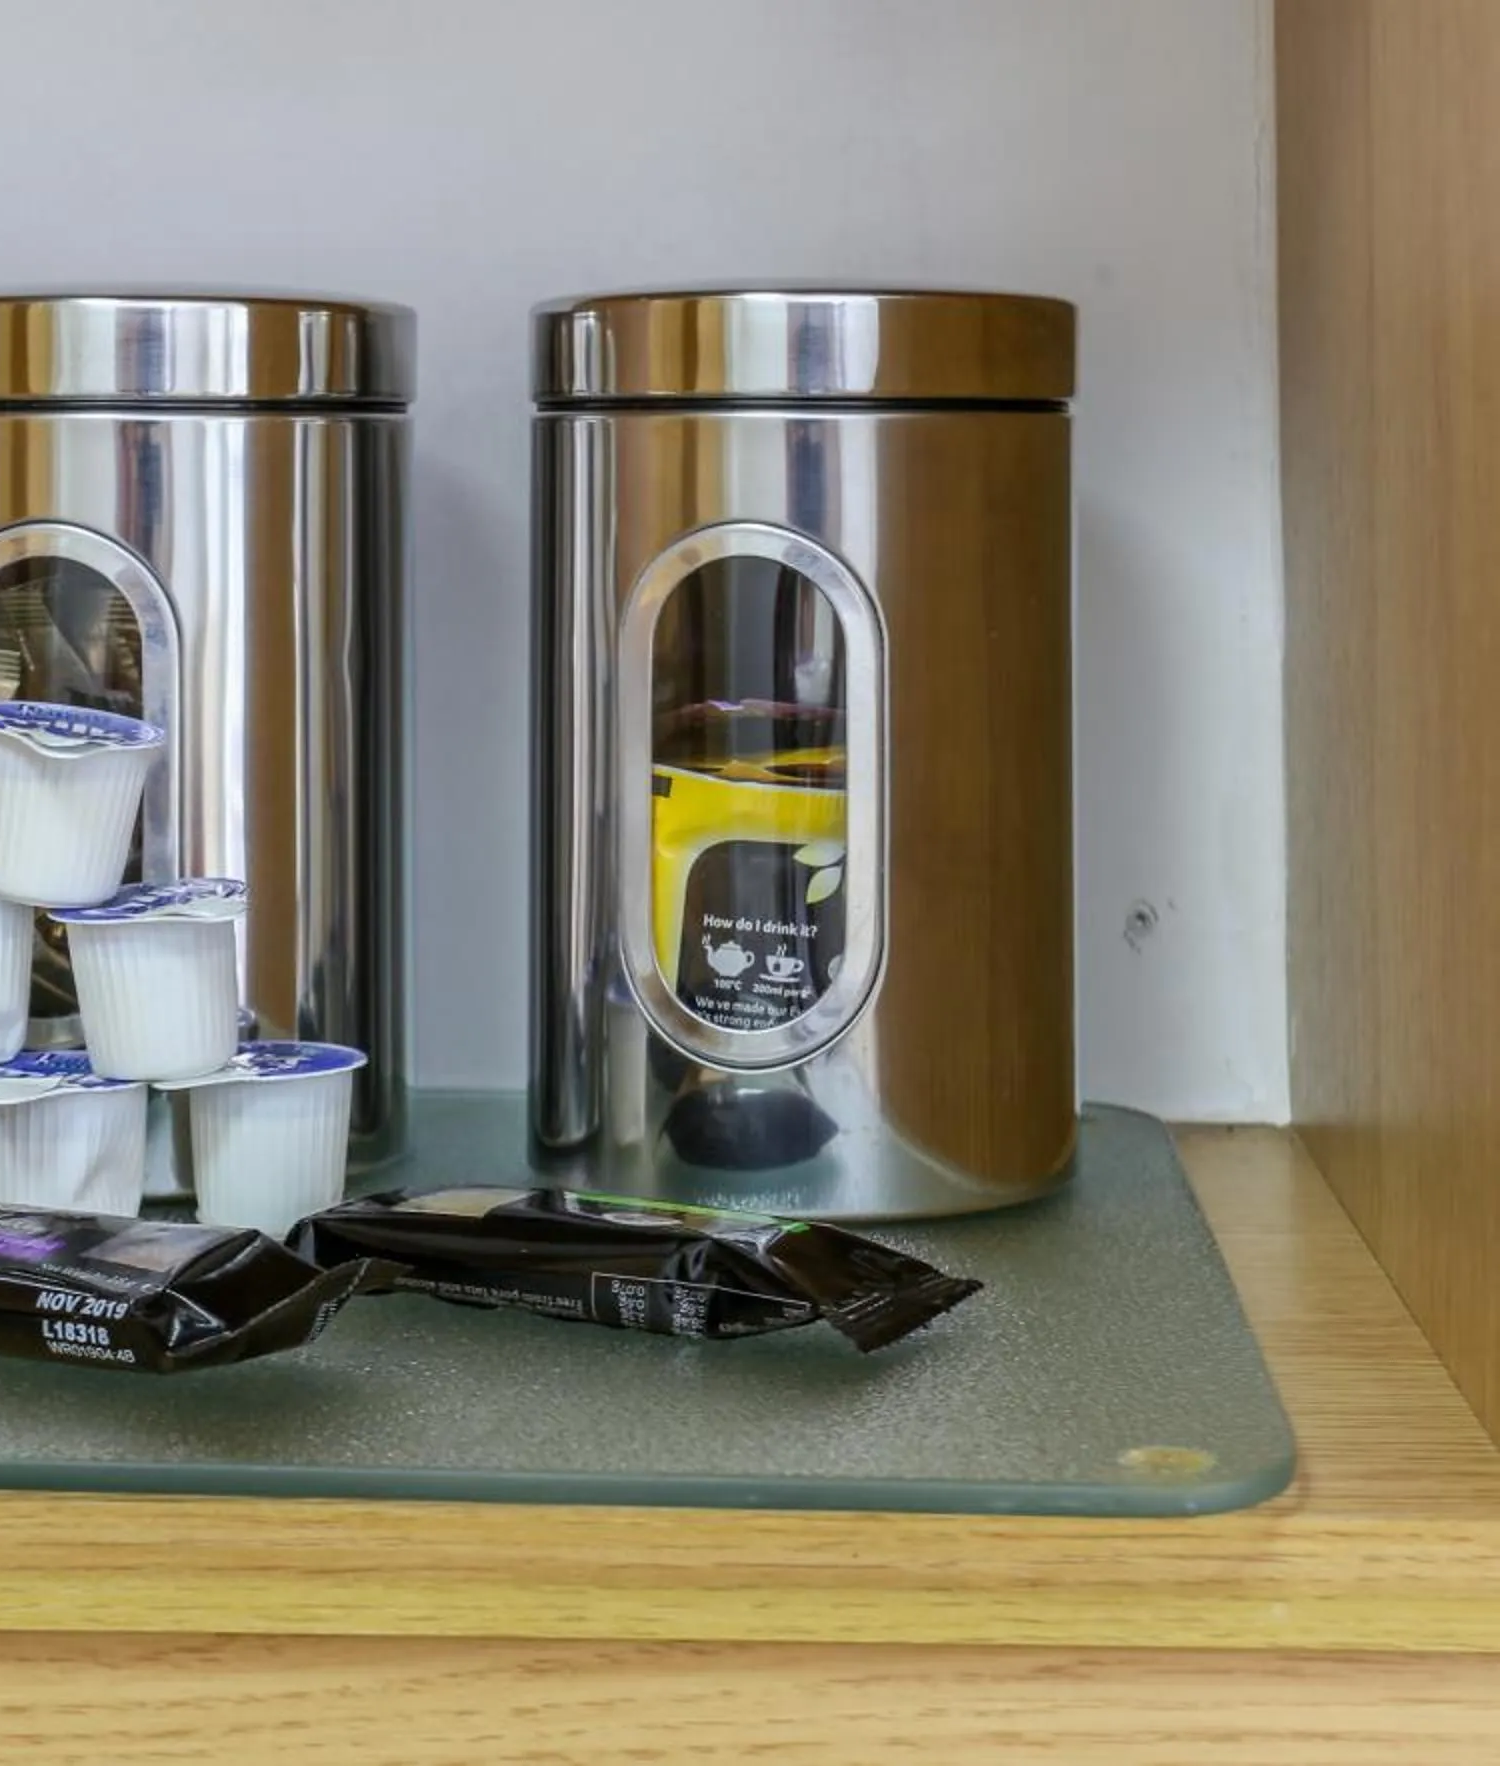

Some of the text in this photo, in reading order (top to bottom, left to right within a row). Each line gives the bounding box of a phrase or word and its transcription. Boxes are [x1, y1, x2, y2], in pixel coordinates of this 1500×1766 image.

[703, 913, 819, 939] How do I drink it?
[731, 1000, 766, 1013] made
[713, 1012, 751, 1029] strong
[35, 1291, 129, 1320] NOV 2019
[41, 1319, 110, 1346] L18318
